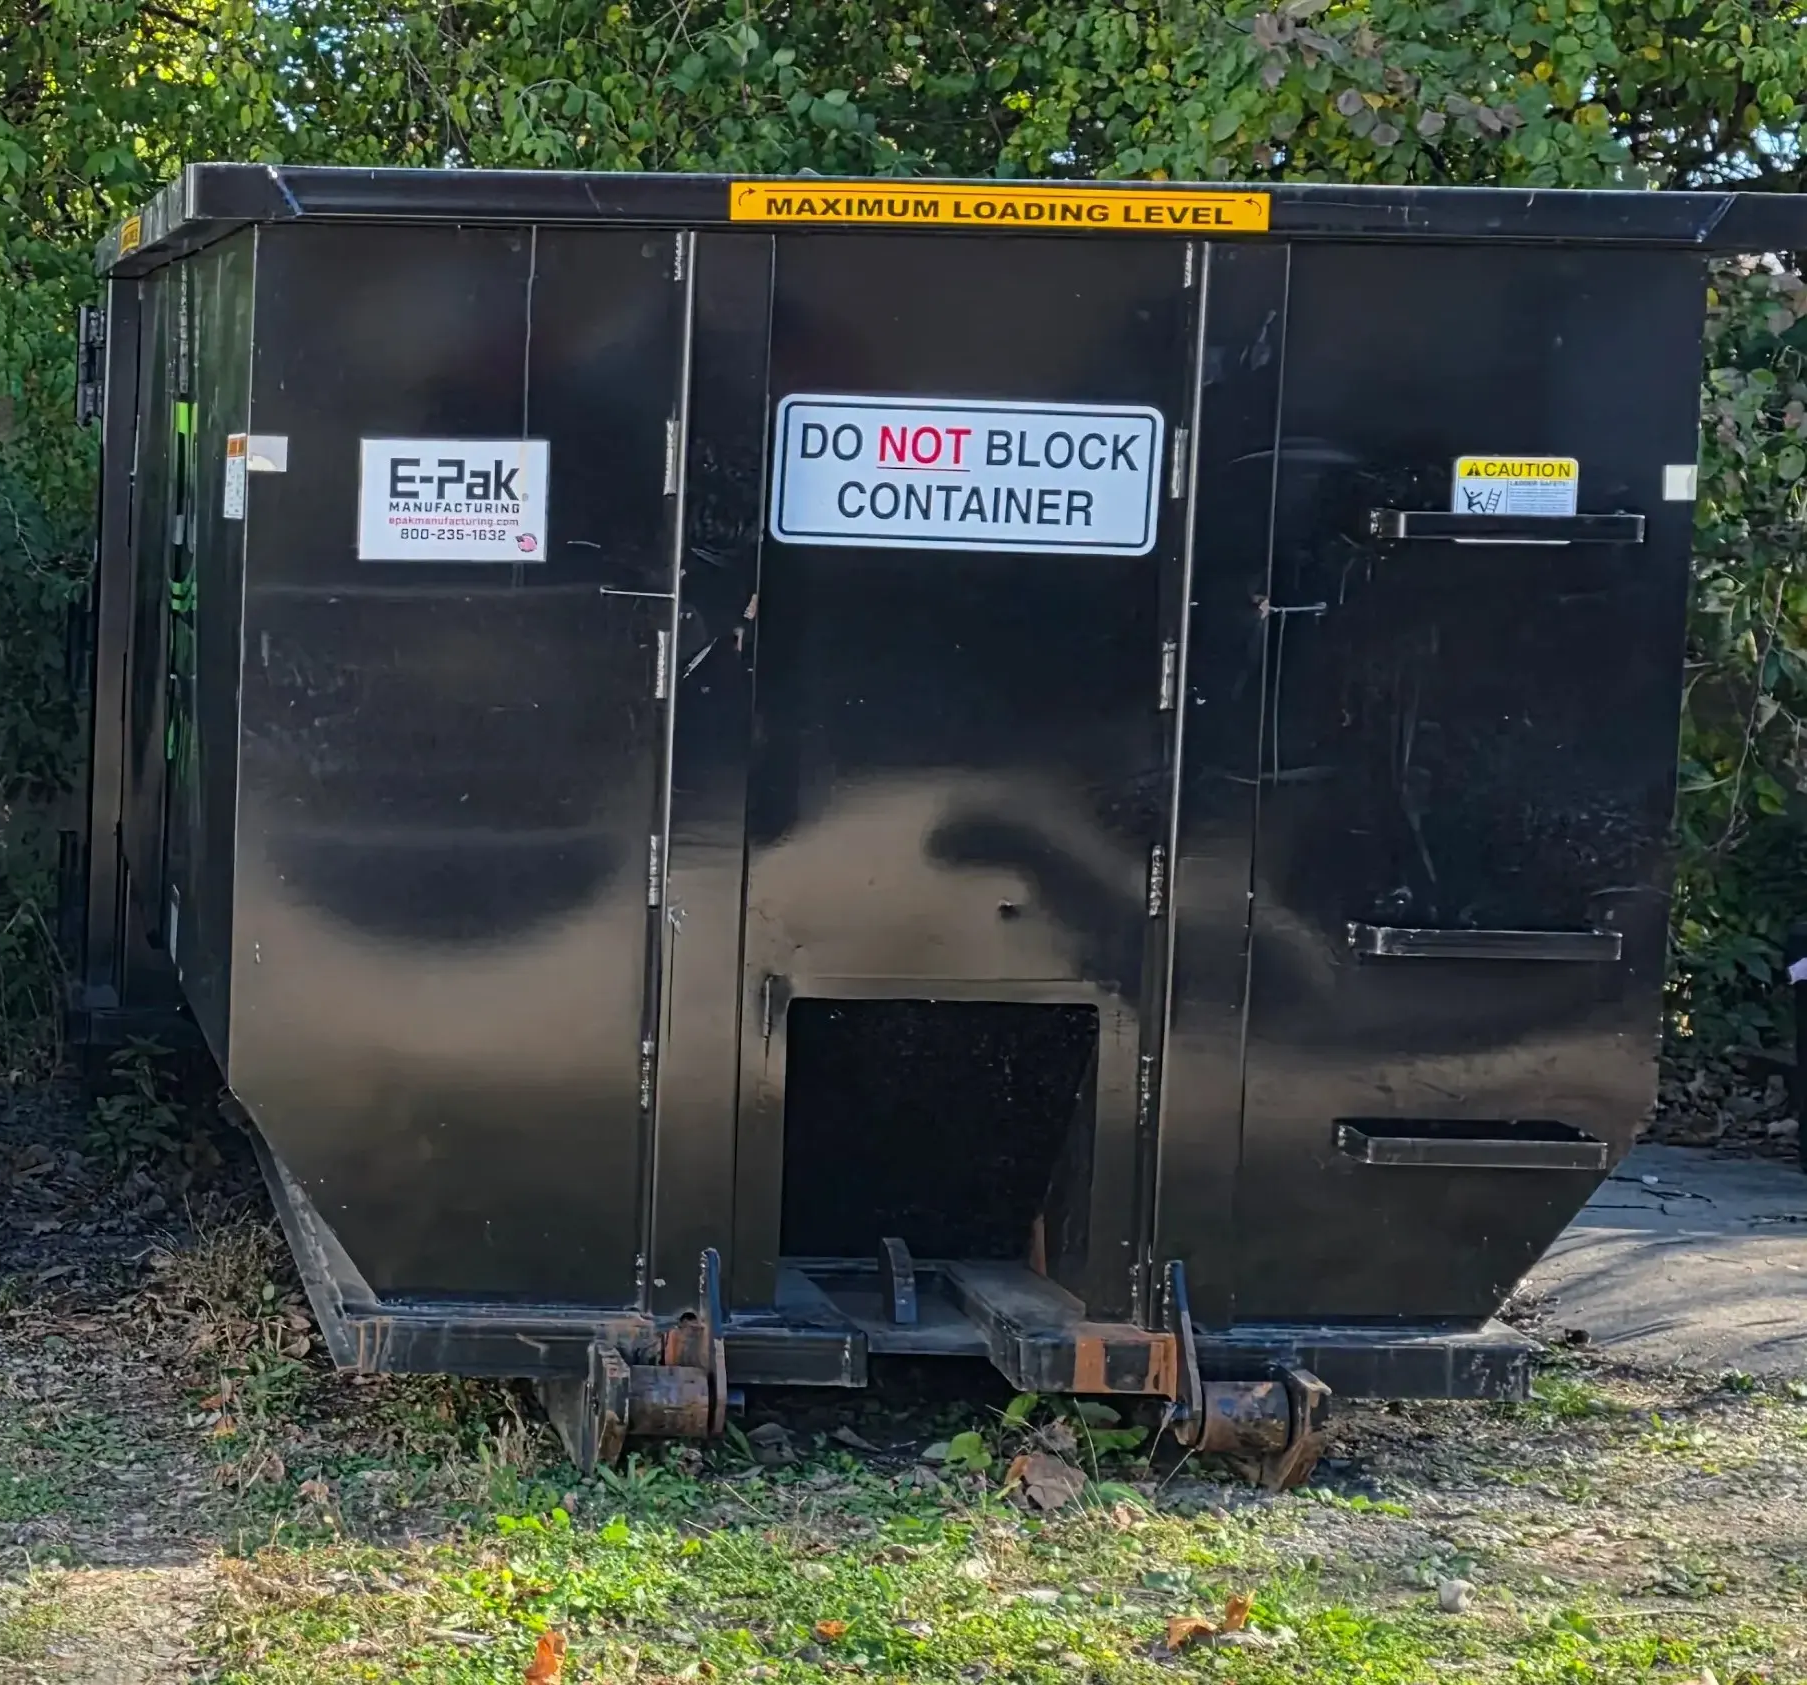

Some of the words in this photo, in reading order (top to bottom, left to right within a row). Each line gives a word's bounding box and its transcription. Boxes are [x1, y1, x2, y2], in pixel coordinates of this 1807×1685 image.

[766, 198, 939, 218] MAXIMUM
[953, 201, 1109, 222] LOADING
[1123, 205, 1233, 225] LEVEL
[800, 422, 863, 461] DO
[878, 425, 972, 465] NOT
[986, 429, 1140, 472] BLOCK
[1484, 462, 1570, 477] CAUTION
[389, 502, 520, 514] MANUFACTURING
[837, 481, 1094, 527] CONTAINER
[388, 516, 519, 528] epakmanufacturing.com
[400, 528, 506, 541] 800-235-1632
